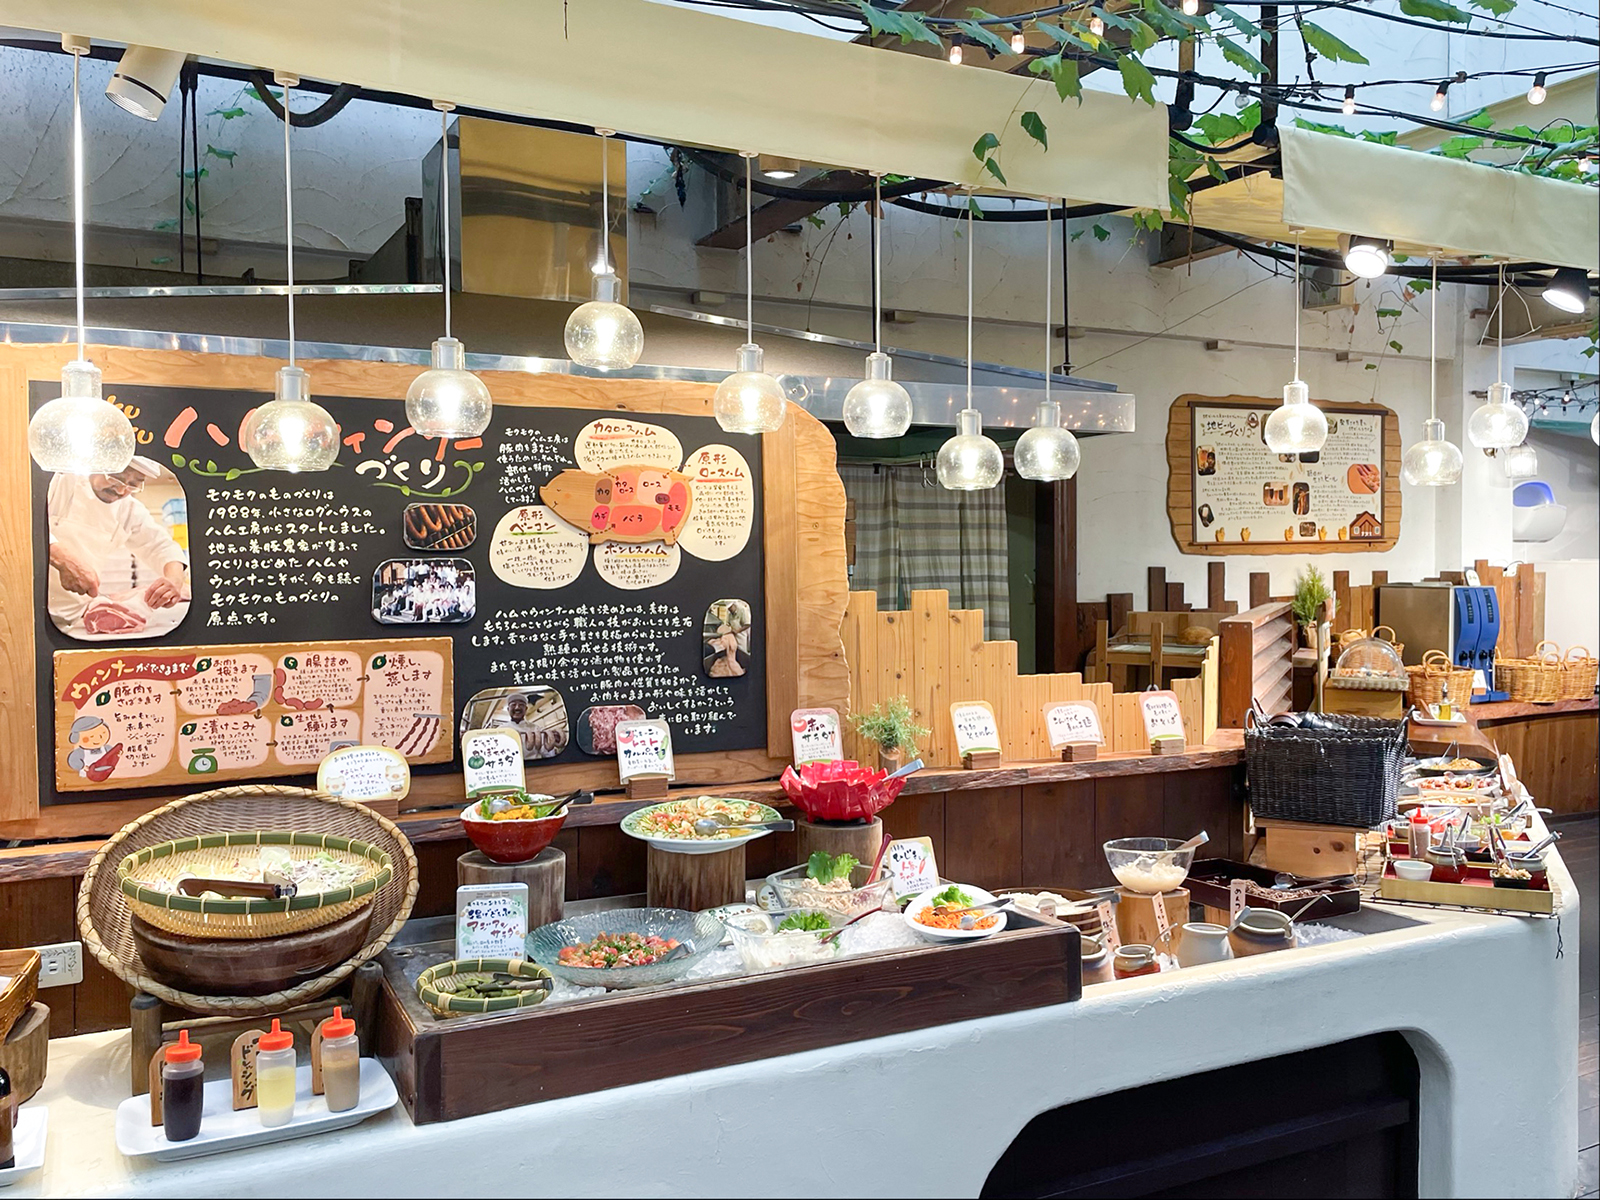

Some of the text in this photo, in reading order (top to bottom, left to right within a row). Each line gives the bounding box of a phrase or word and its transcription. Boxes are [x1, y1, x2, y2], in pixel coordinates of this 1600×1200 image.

[593, 422, 657, 436] カタロースハム
[1207, 420, 1236, 430] 地ビール
[1224, 426, 1246, 438] づくり
[504, 428, 541, 437] モクモクの
[530, 434, 569, 444] ハム工房は
[499, 442, 559, 454] 豚肉をまるごと
[698, 452, 727, 464] 原形
[355, 455, 446, 490] づくり
[699, 467, 745, 478] ロースハム
[499, 474, 531, 486] 活かした
[206, 486, 335, 502] モクモクのものづくりは
[596, 488, 610, 496] カタ
[505, 495, 534, 504] しています。
[208, 504, 373, 520] 1988年、小さなログハウスの
[517, 508, 544, 522] 原形
[668, 504, 682, 512] モモ
[594, 512, 608, 520] ウデ
[622, 514, 643, 522] バラ
[205, 521, 386, 536] ハム工房からスタートしました。
[509, 522, 558, 533] ベーコン
[208, 538, 358, 555] 地元の養豚農家が集まって
[604, 542, 668, 556] ボンレスハム
[208, 556, 350, 570] つくりはじめたハムや
[209, 572, 362, 589] ウィンナーこそが、今も続く
[210, 589, 340, 608] モクモクのものづくりの
[496, 602, 680, 618] ハムやウィンナーの味を決めるのは、素材は
[206, 610, 277, 627] 原点です。
[484, 616, 692, 632] もちろんのことながら職人の技がおいしさを左右
[472, 630, 684, 646] します。舌ではなく手で旨さを見極められることが
[543, 642, 659, 656] 熟練の成せる技術です。
[306, 654, 349, 668] 腸詰め
[490, 652, 666, 673] またできる限り余分な添加物を使わず
[70, 659, 190, 699] ウィンナーができるまで
[384, 670, 432, 687] 蒸します
[514, 666, 680, 684] 素材の味を活かした製品をつくるため
[570, 675, 698, 692] いかに豚肉の性質を知るか？
[114, 684, 152, 698] 豚肉を
[590, 686, 728, 702] お肉そのままの形や味を活かして
[117, 694, 162, 707] さばきます
[648, 697, 734, 712] おいしくするか？という
[202, 720, 256, 734] 漬けこみ
[304, 717, 348, 732] 練ります
[684, 723, 716, 735] います。
[802, 731, 832, 742] サラダ
[485, 751, 519, 768] サラダ
[1234, 888, 1242, 914] めんつ
[466, 920, 508, 932] アジアン
[490, 924, 518, 938] サラダ
[241, 1044, 254, 1101] ドレッシング
